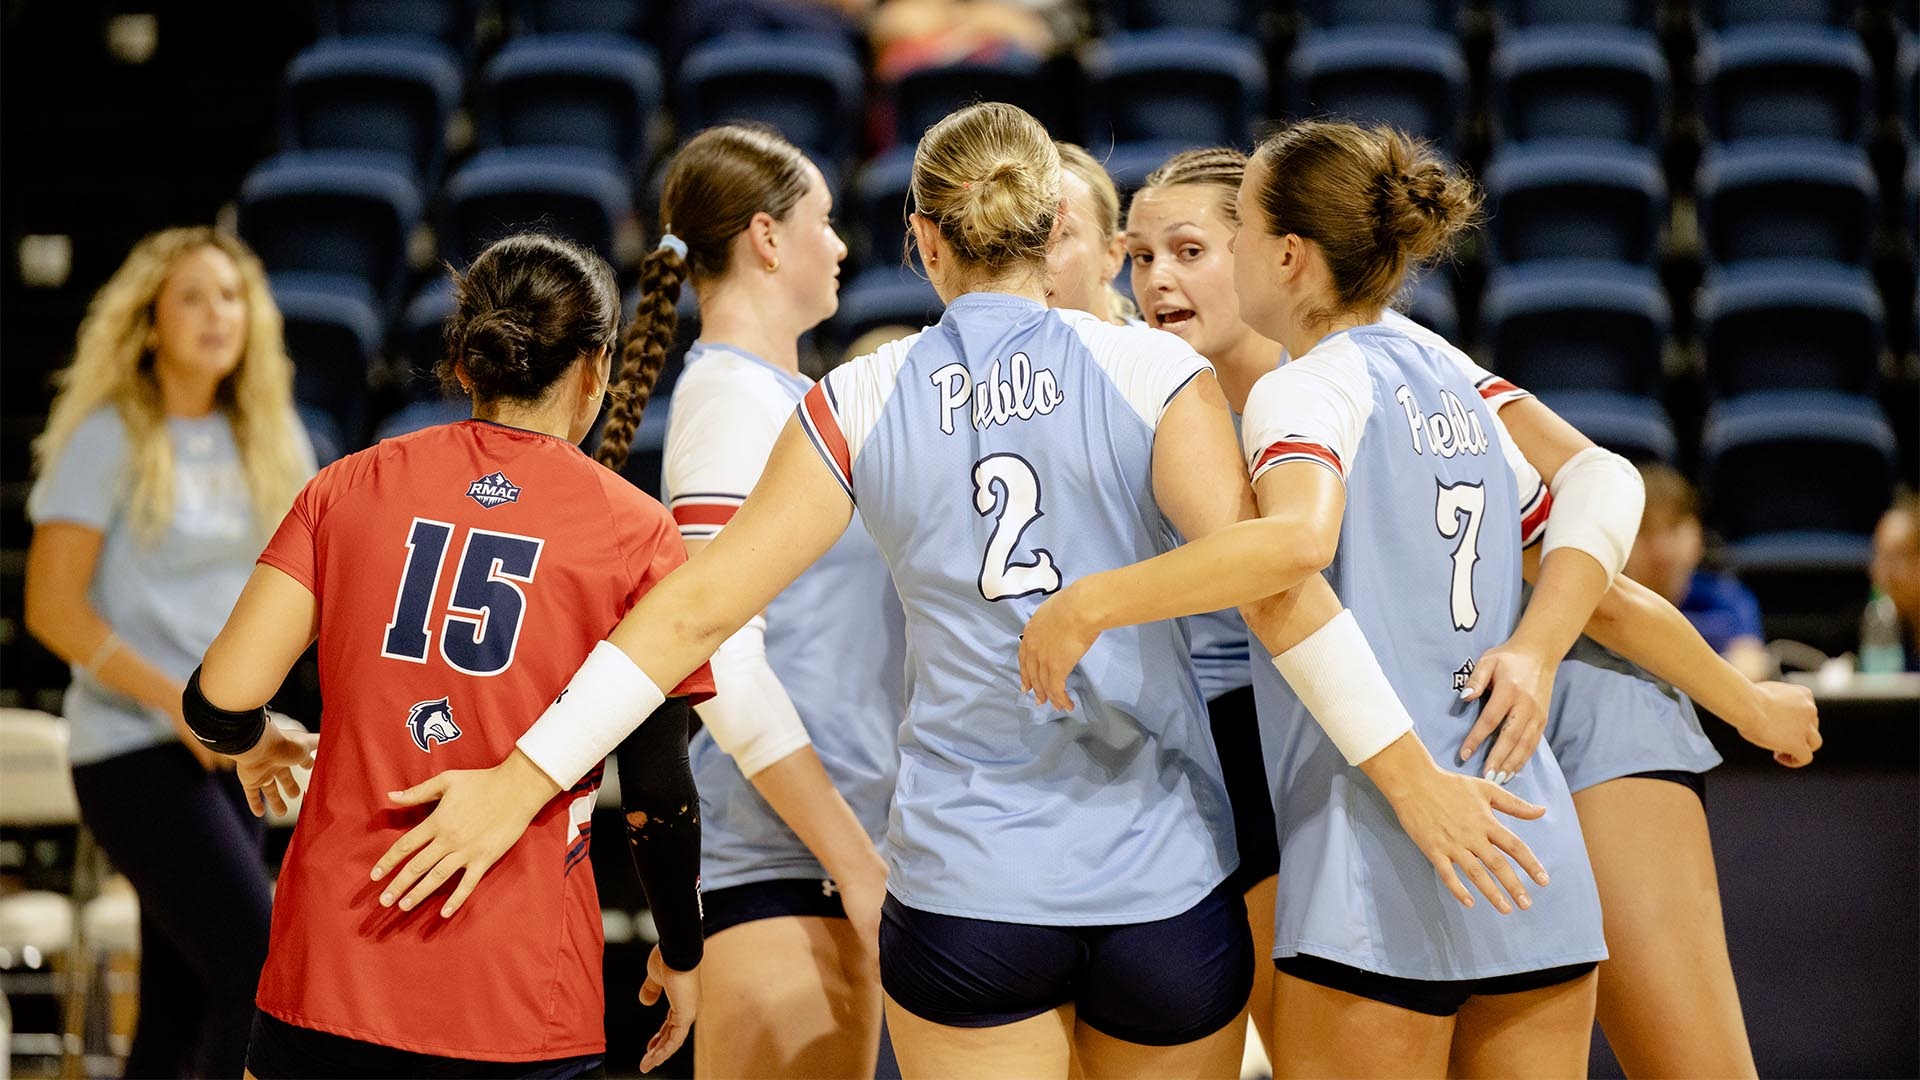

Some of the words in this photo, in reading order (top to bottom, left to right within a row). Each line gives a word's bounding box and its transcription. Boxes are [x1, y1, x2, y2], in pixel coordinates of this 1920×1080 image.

[929, 351, 1065, 436] Peblo
[469, 483, 519, 501] RMAC
[971, 452, 1062, 602] 2
[1435, 474, 1486, 632] 7
[380, 516, 545, 677] 15
